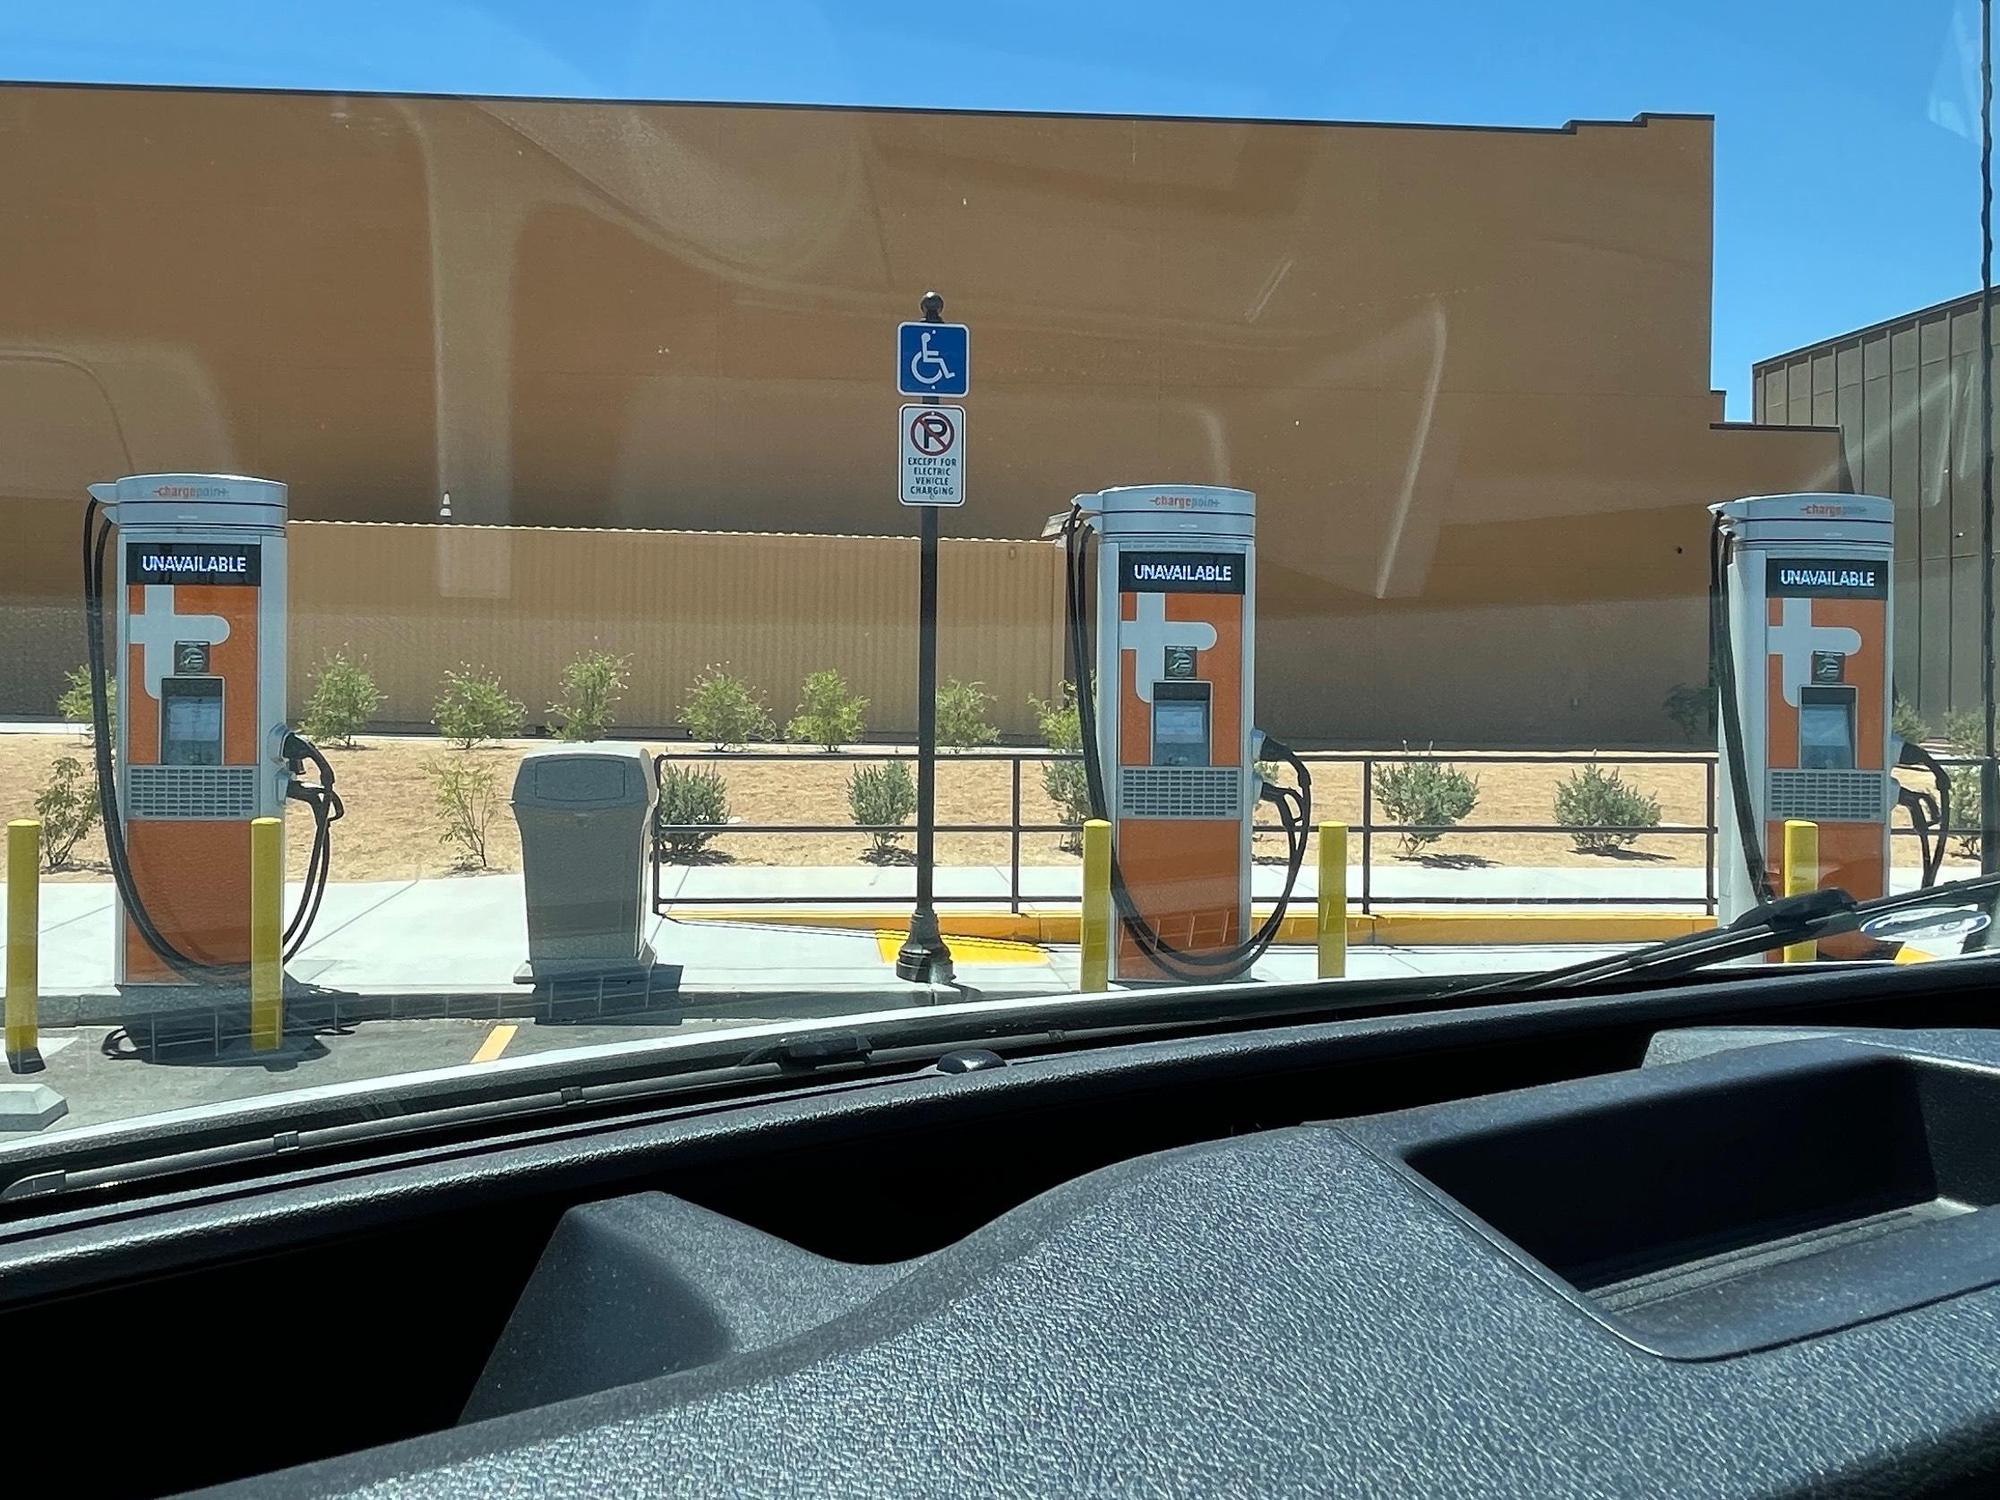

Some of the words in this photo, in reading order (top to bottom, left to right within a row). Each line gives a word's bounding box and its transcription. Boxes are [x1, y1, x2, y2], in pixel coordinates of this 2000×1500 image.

[908, 457, 937, 466] EXCEPT
[940, 458, 957, 466] FOR
[913, 467, 951, 476] ELECTRIC
[915, 477, 949, 485] VEHICLE
[910, 486, 954, 495] CHARGING
[142, 555, 247, 572] UNAVAILABLE
[1134, 564, 1232, 581] UNAVAILABLE
[1780, 569, 1875, 587] UNAVAILABLE
